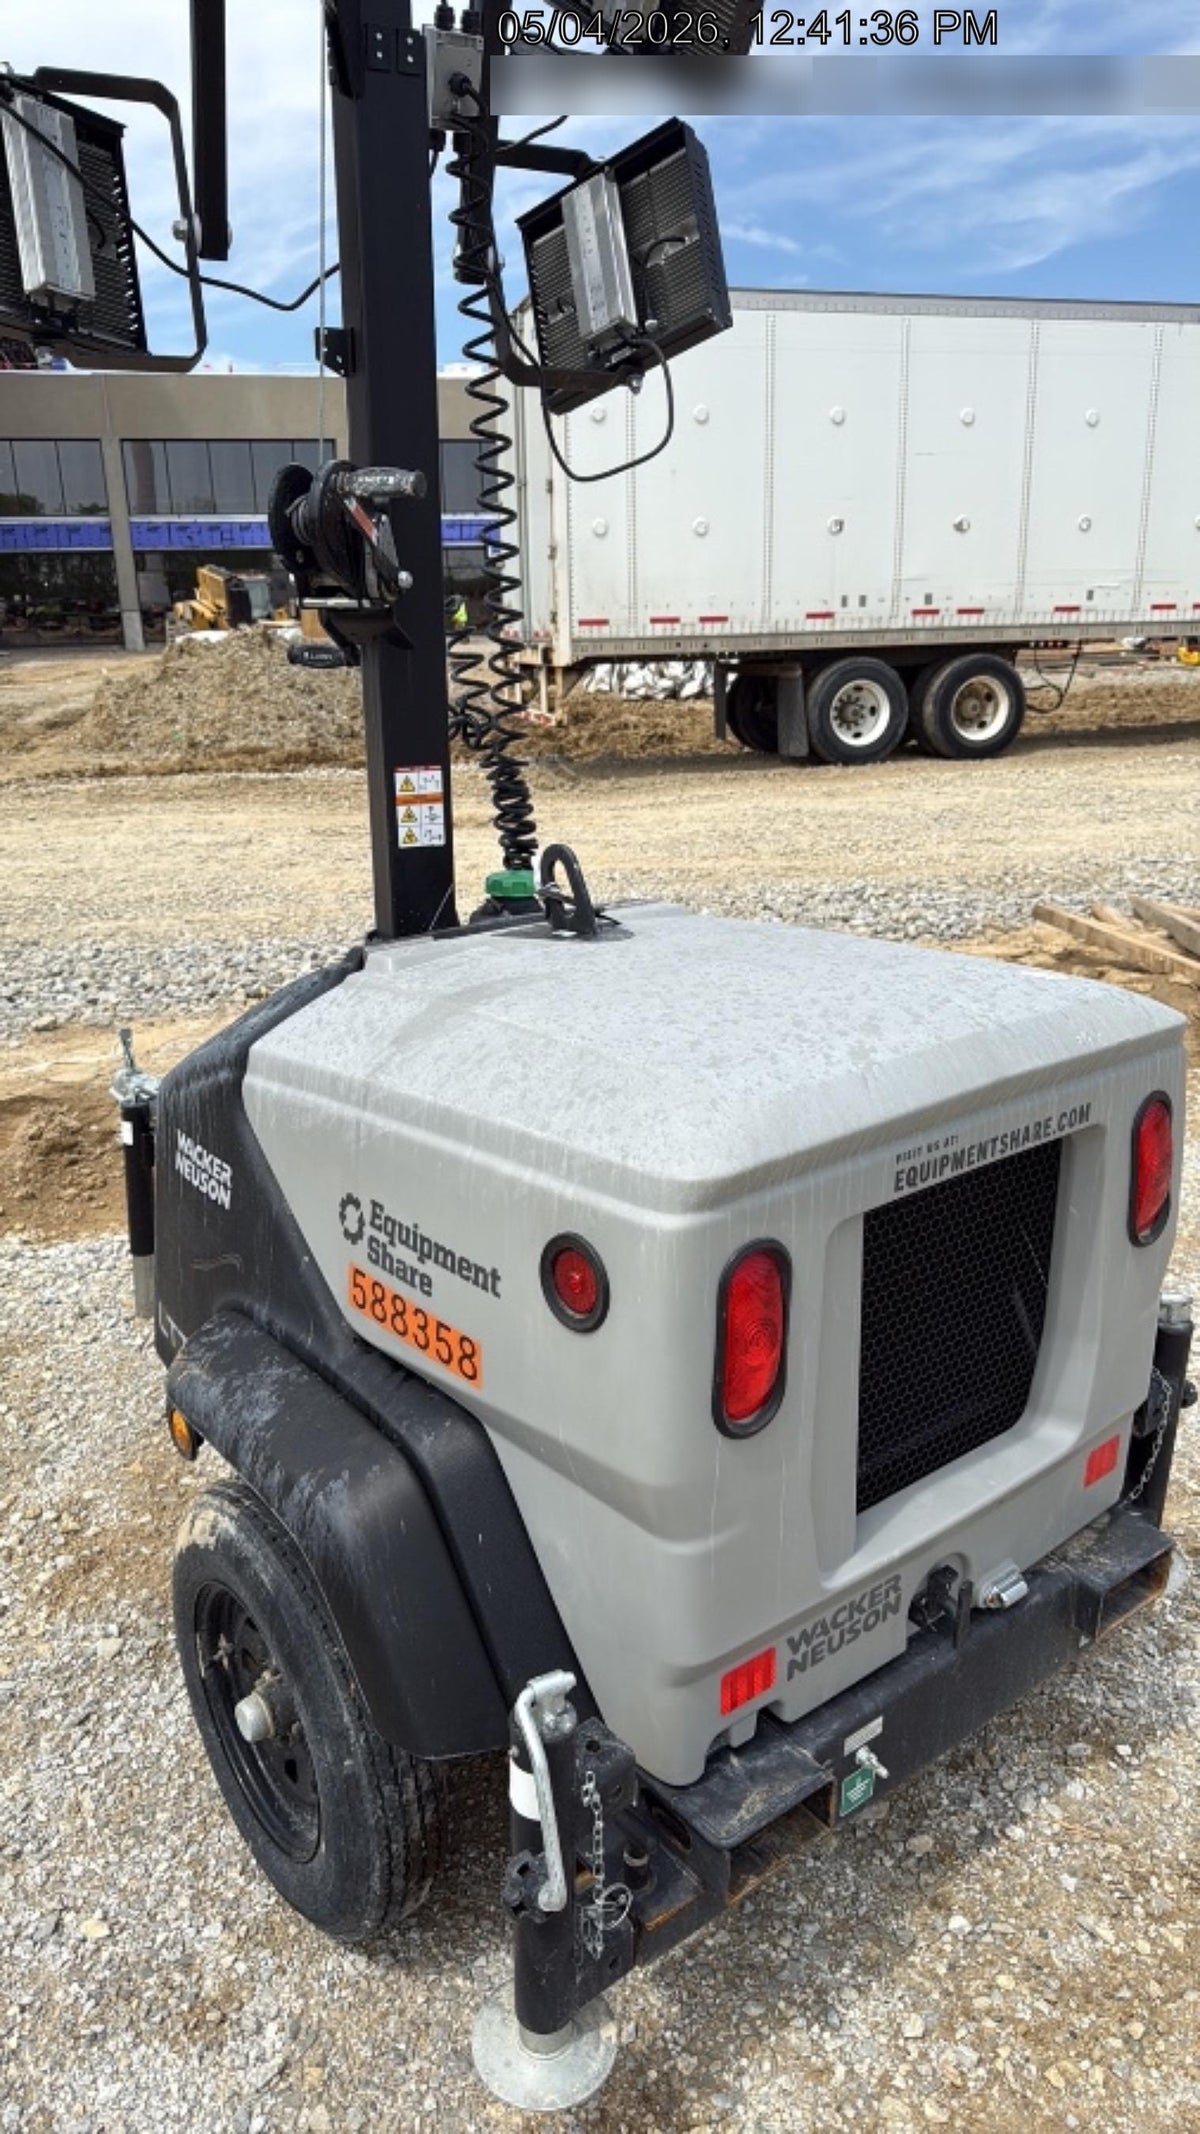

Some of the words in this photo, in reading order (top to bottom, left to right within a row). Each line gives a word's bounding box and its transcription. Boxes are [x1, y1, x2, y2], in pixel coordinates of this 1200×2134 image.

[175, 1151, 231, 1210] NEUSON
[177, 1128, 233, 1188] WACKER
[893, 1102, 1092, 1192] EQUIPMENTSHARE.COM
[367, 1234, 433, 1297] Share
[369, 1199, 502, 1299] Equipment
[352, 1268, 478, 1381] 588358
[786, 1574, 902, 1655] WACKER
[787, 1592, 902, 1682] NEUSON
